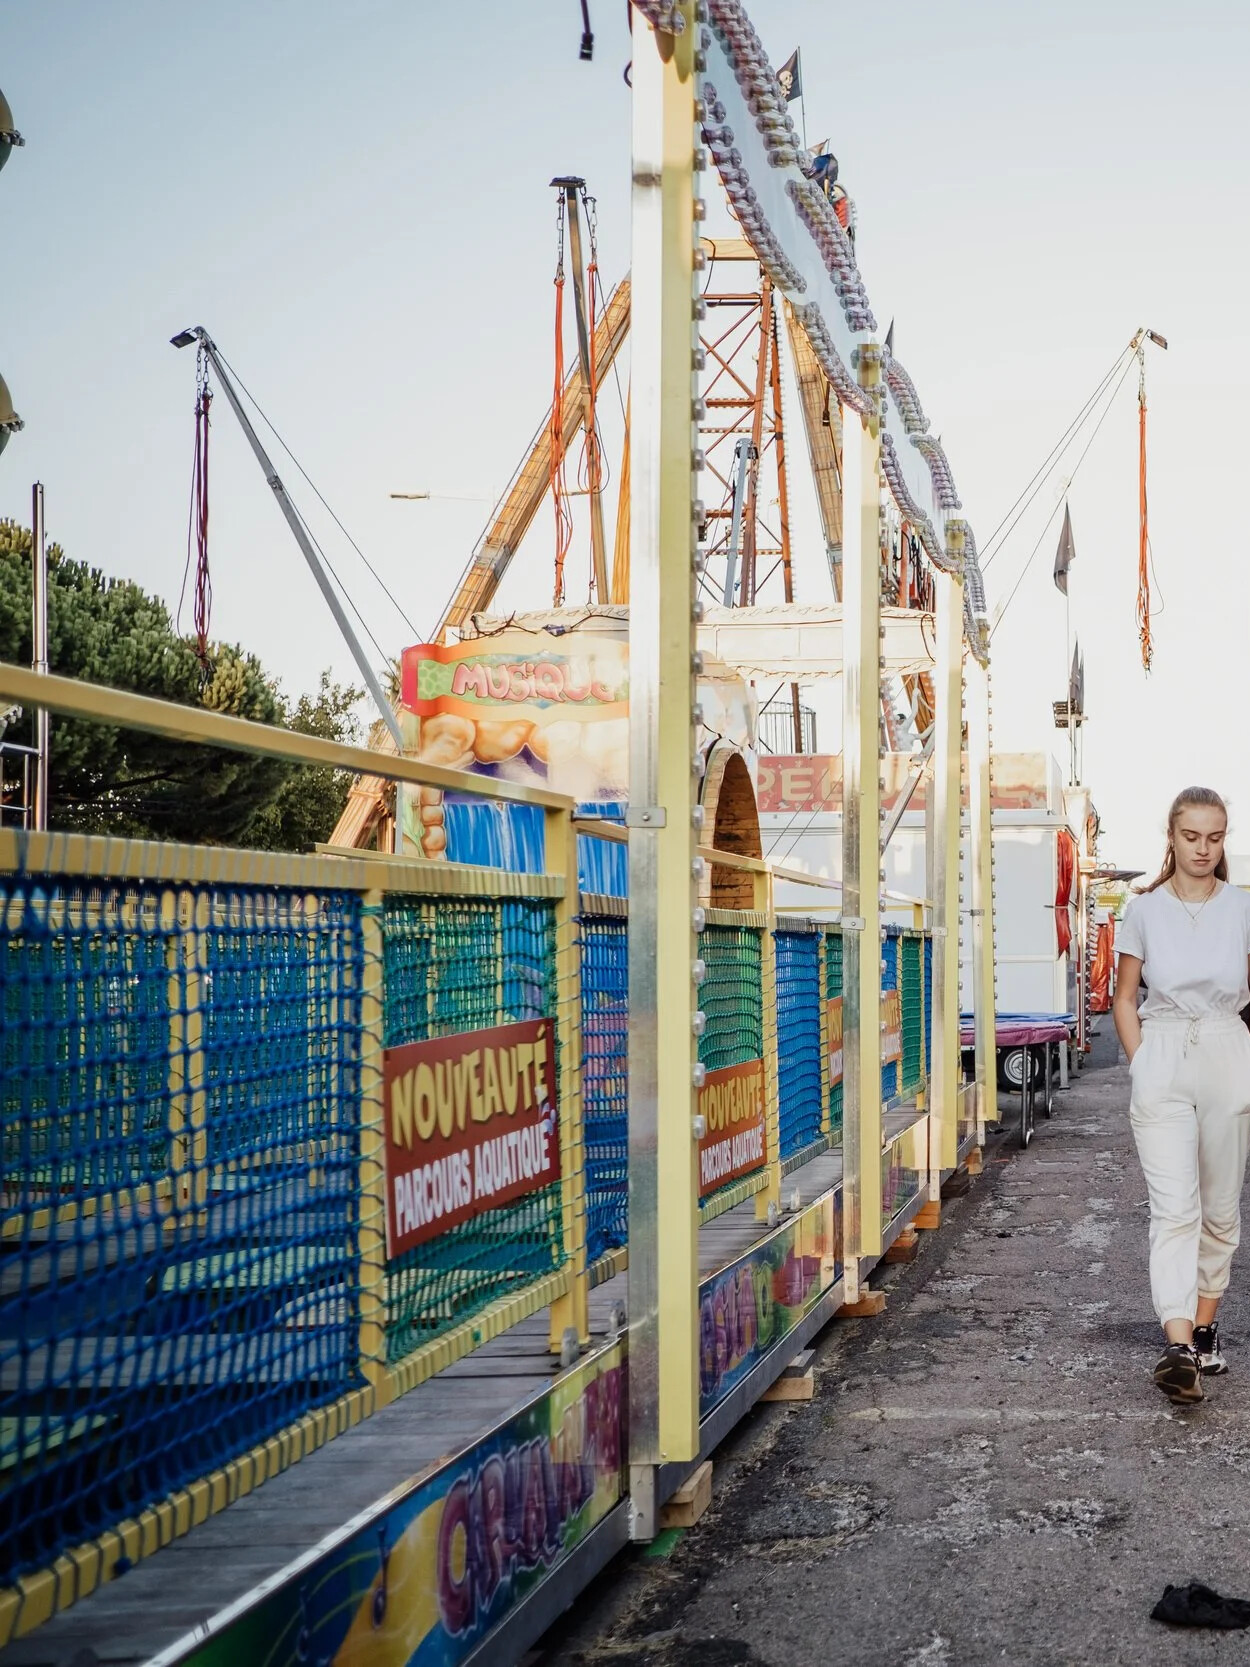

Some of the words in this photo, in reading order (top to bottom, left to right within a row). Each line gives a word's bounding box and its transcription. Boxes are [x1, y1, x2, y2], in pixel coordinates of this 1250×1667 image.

[391, 1023, 549, 1151] NOUVEAUTÉ
[394, 1148, 472, 1238] PARCOURS
[474, 1121, 550, 1199] AQUATIQUE
